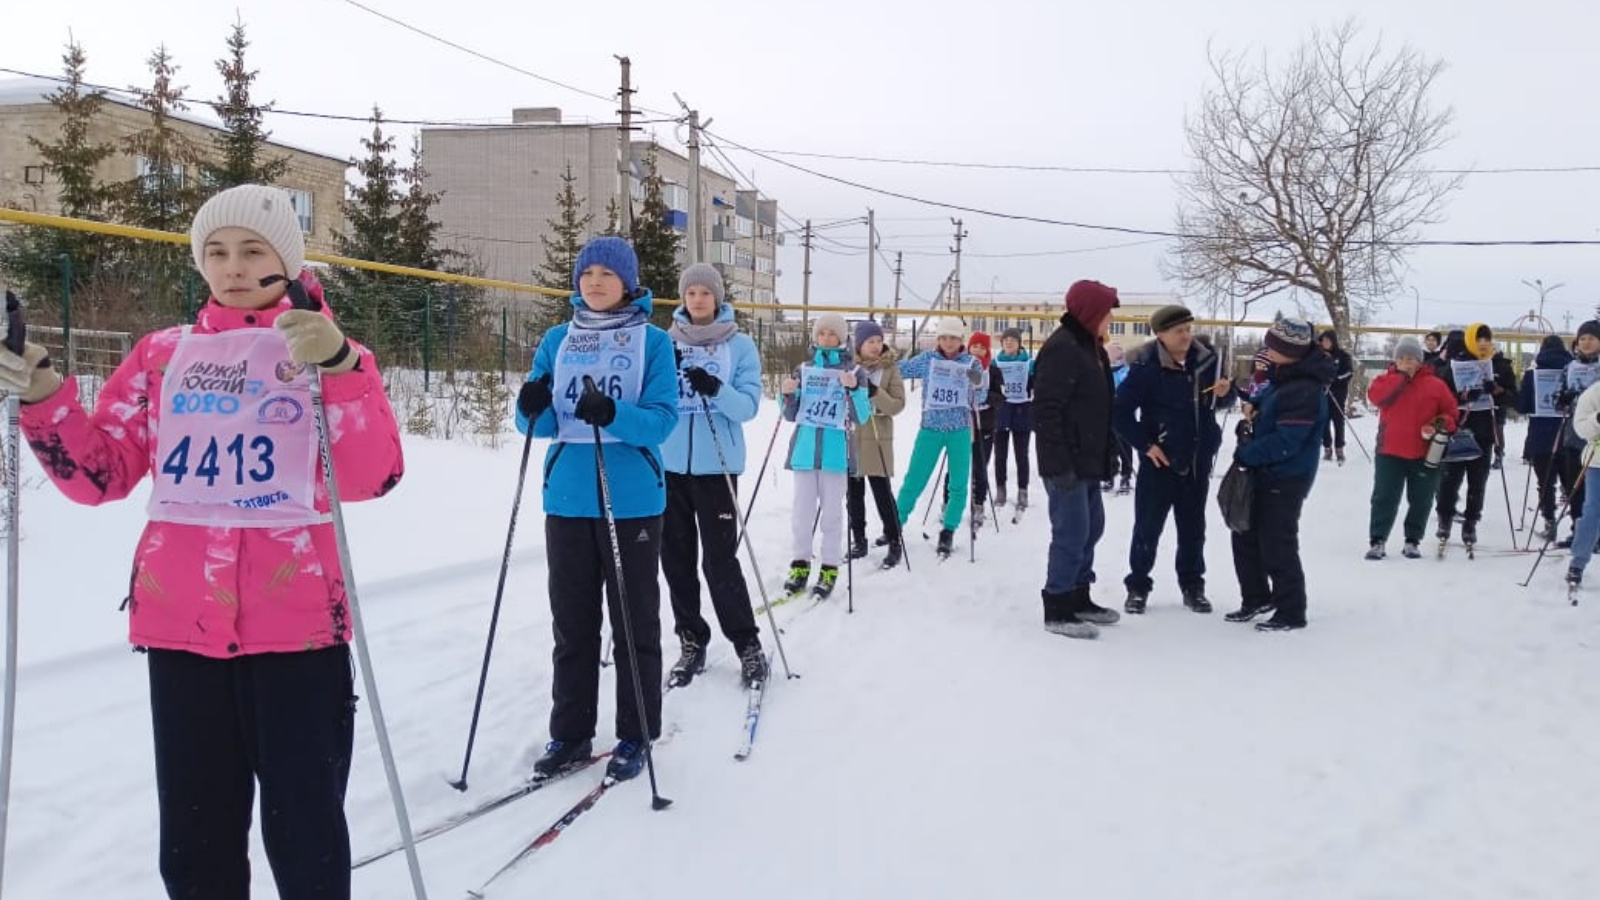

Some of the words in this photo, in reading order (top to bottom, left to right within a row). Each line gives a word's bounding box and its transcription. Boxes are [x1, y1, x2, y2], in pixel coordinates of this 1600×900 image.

[565, 375, 622, 404] 416
[932, 387, 959, 404] 4381
[1004, 382, 1023, 394] 385
[172, 392, 241, 415] 2020
[162, 433, 275, 487] 4413
[233, 490, 290, 509] Татарста
